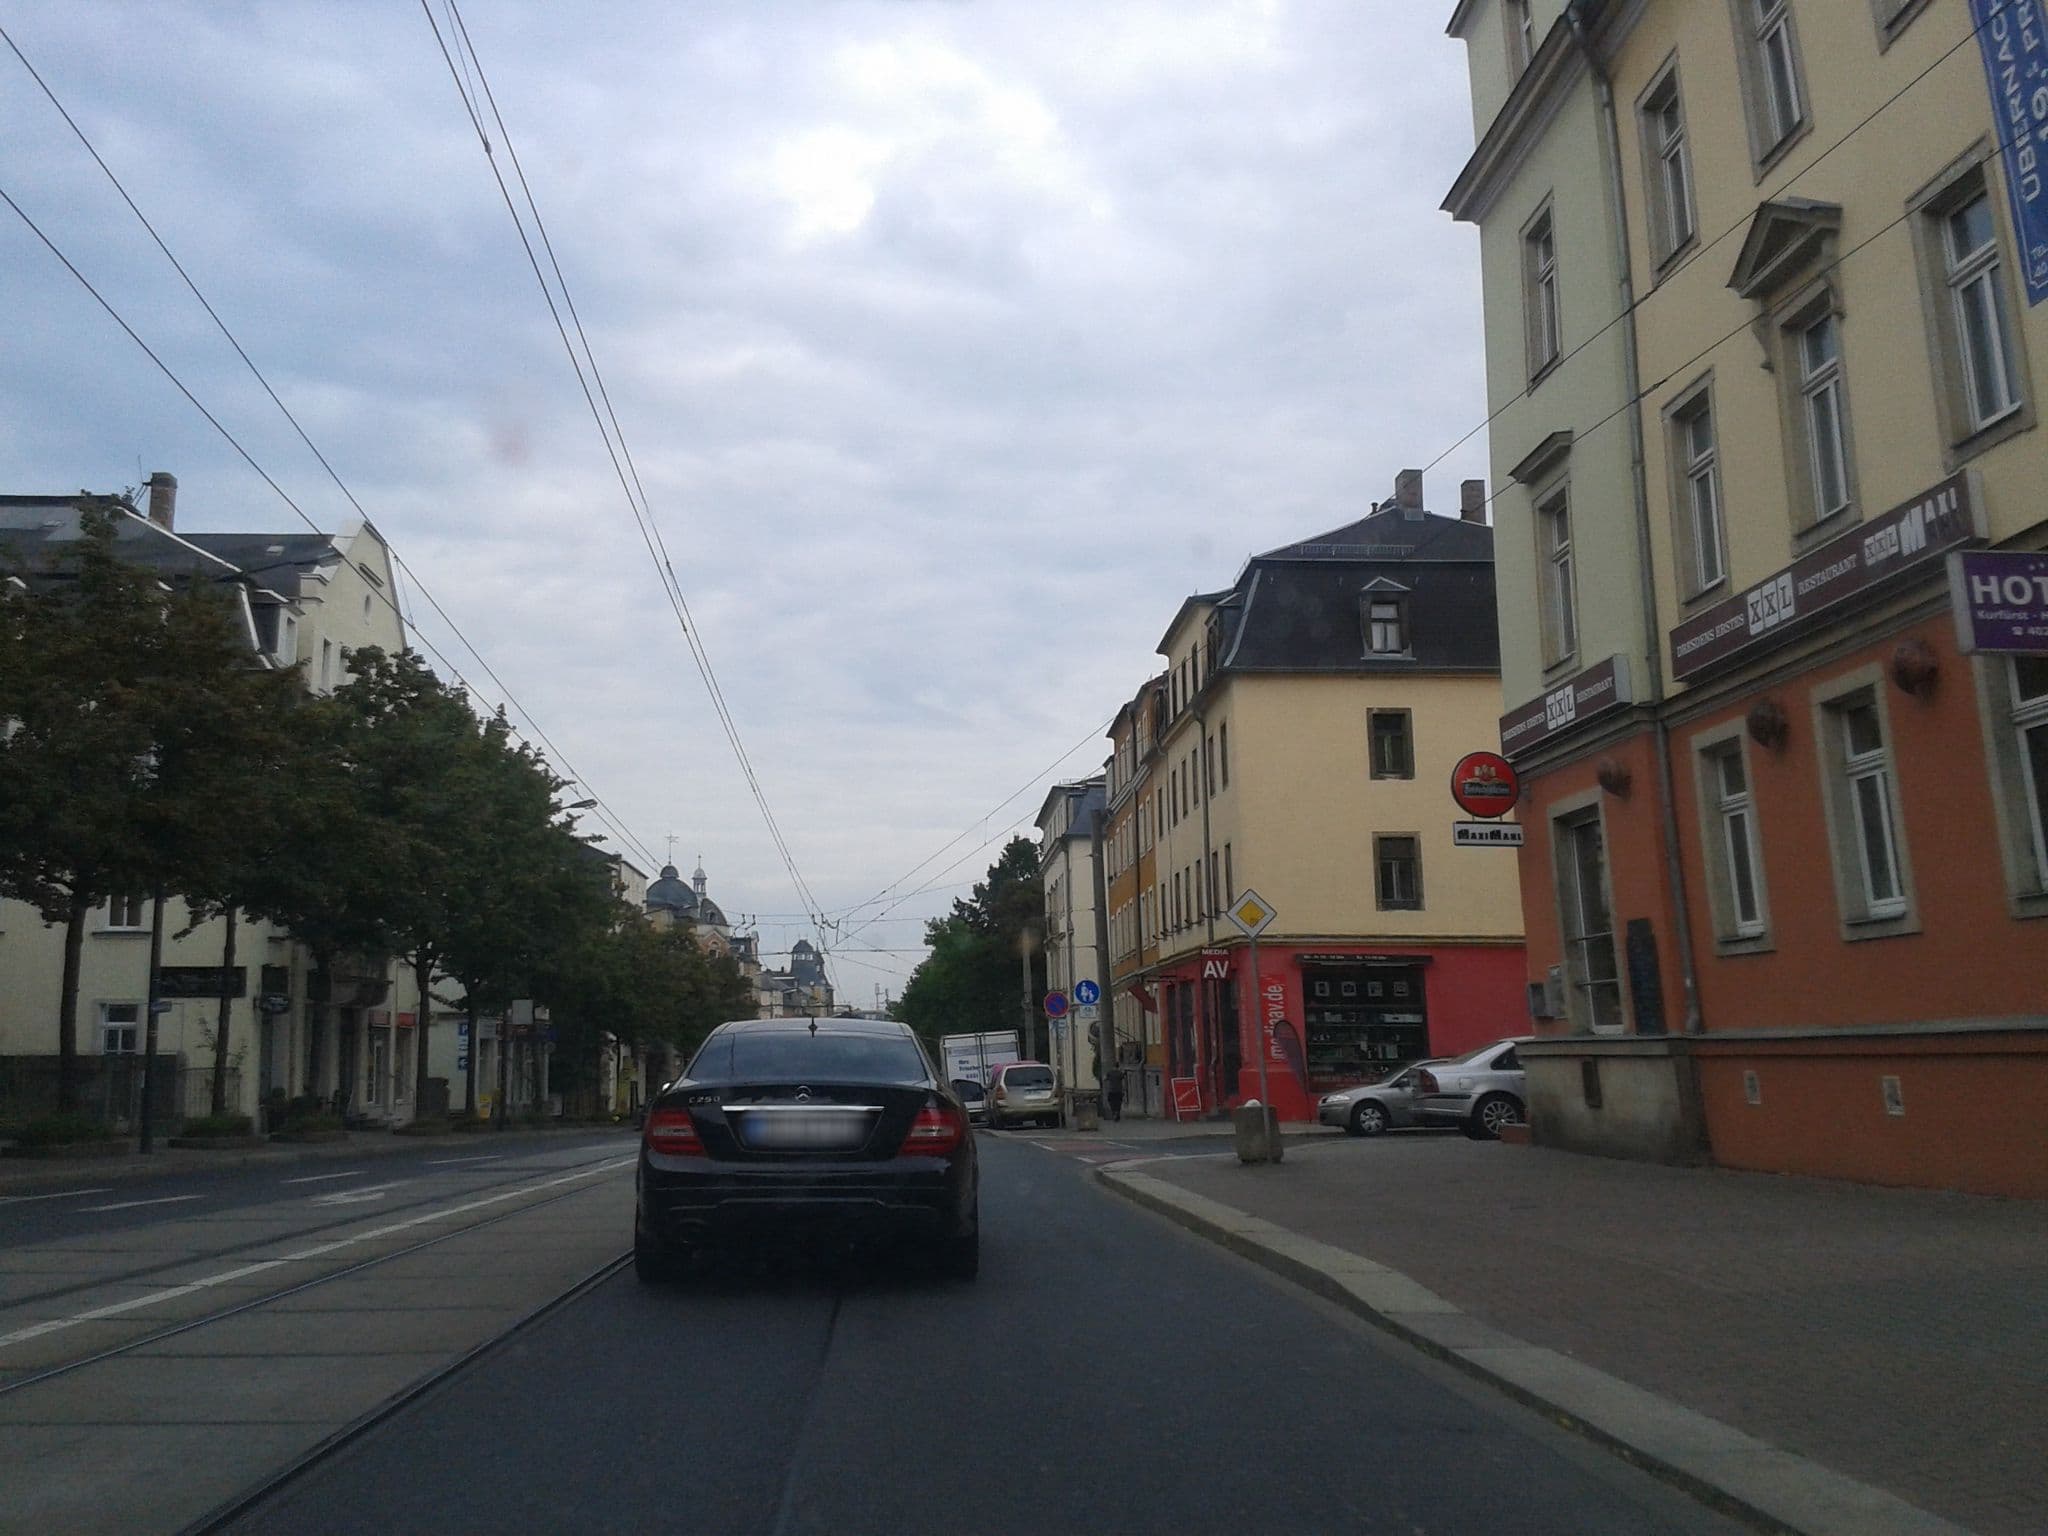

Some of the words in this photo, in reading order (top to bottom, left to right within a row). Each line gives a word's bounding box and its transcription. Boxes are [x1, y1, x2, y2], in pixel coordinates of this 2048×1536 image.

[1749, 580, 1793, 630] XXL
[1797, 554, 1857, 596] RESTAURANT
[1864, 528, 1899, 563] XXL
[1547, 689, 1575, 726] XXL
[1576, 676, 1613, 704] RESTAURANT
[1201, 948, 1229, 956] MEDIA
[1203, 960, 1229, 979] AV
